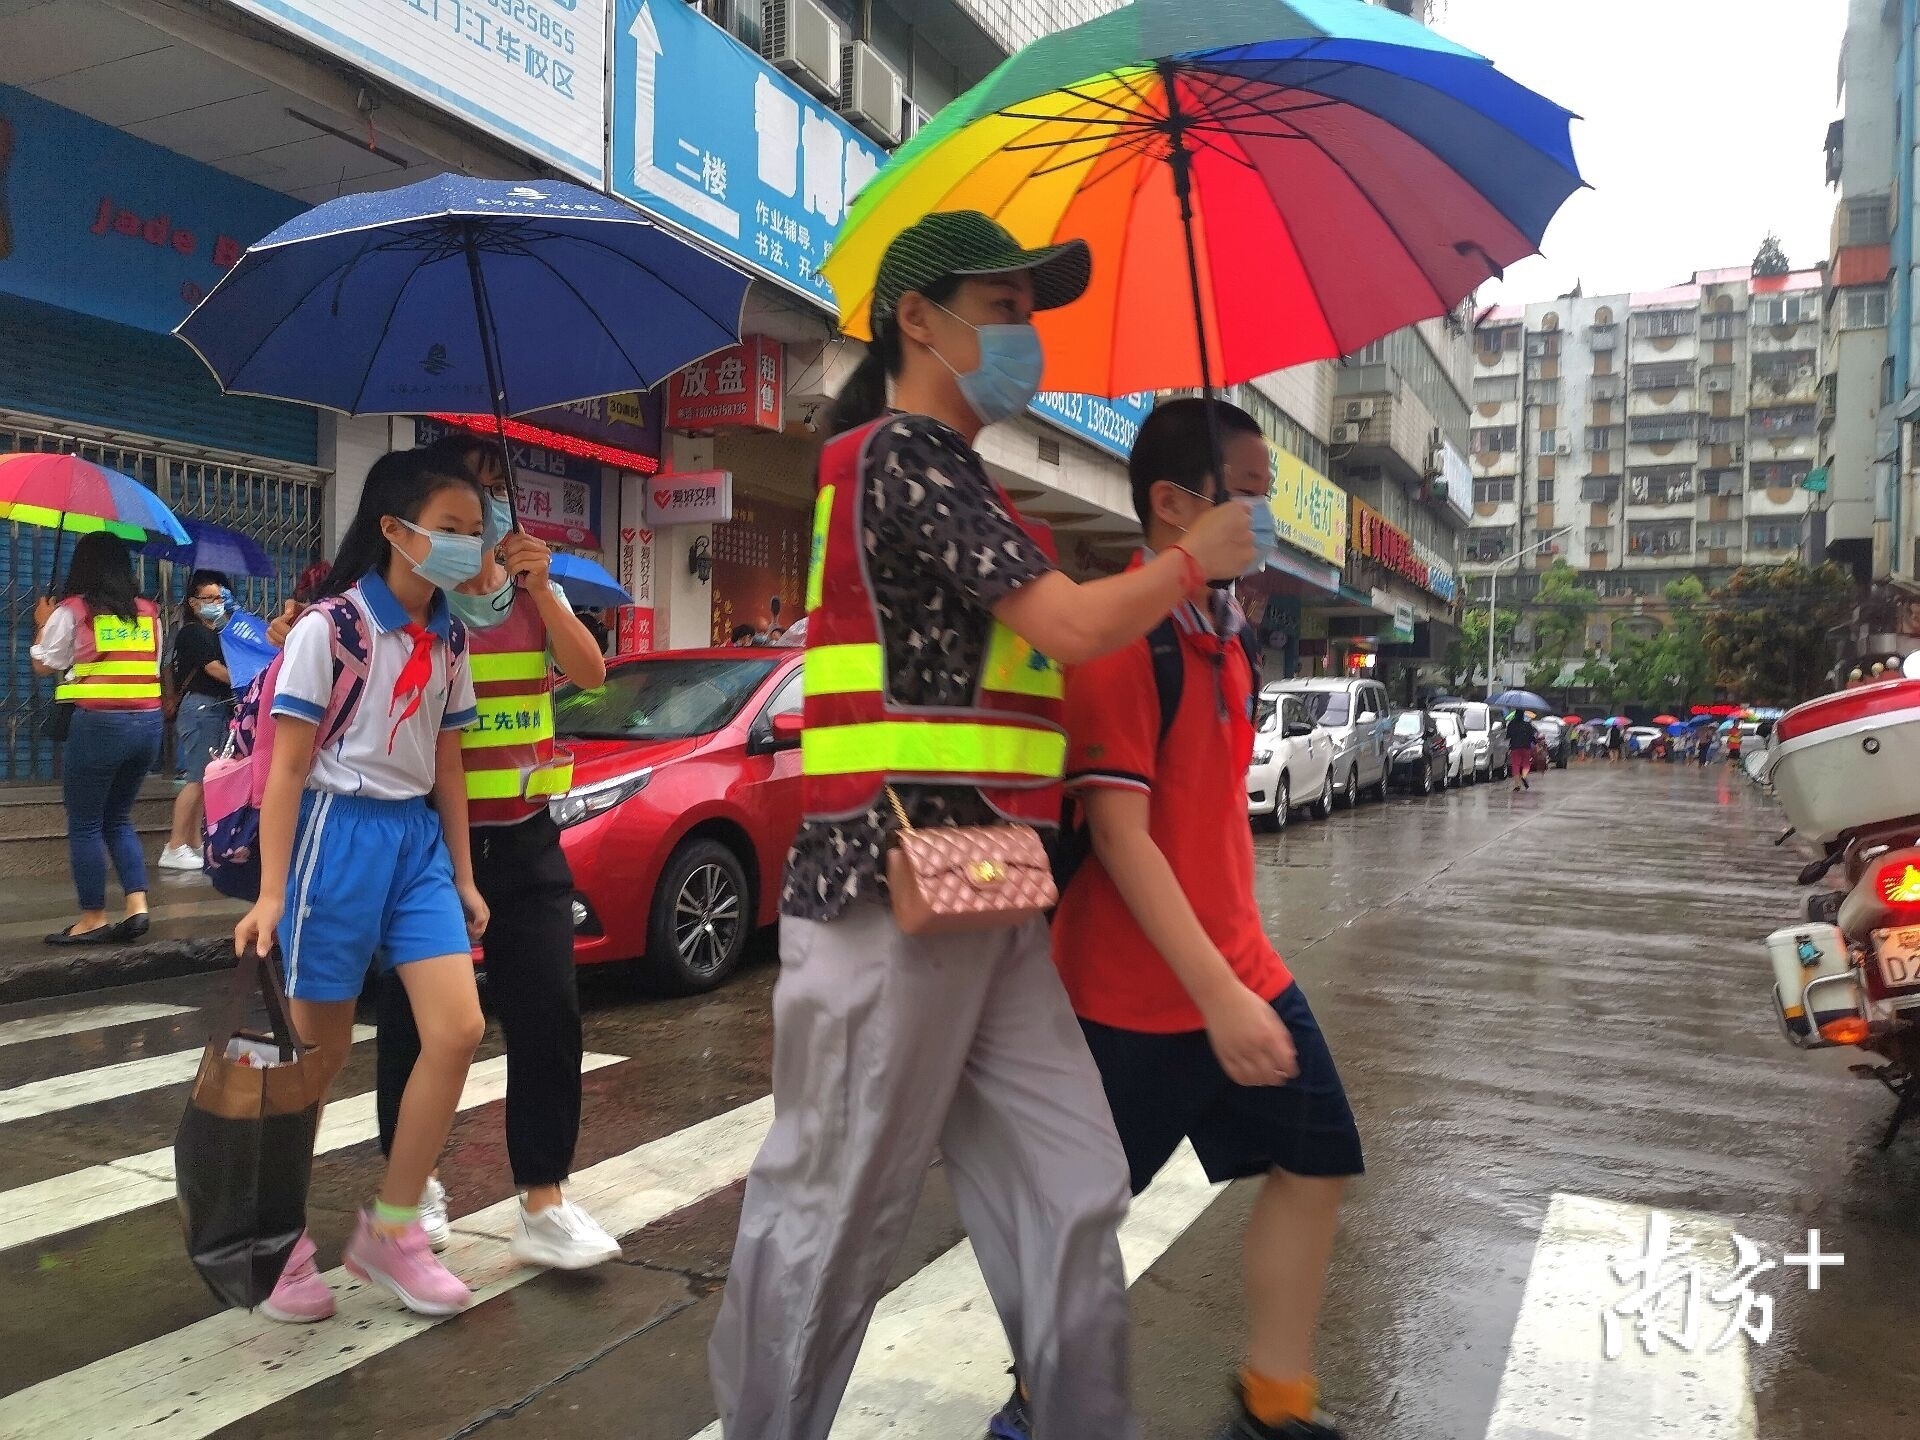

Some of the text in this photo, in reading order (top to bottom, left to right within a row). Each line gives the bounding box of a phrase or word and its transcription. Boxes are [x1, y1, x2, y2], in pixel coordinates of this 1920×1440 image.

[675, 138, 727, 200] 二楼
[213, 234, 241, 268] B
[681, 357, 747, 397] 放盘
[760, 354, 776, 413] 租售
[672, 486, 717, 504] 爱好文具
